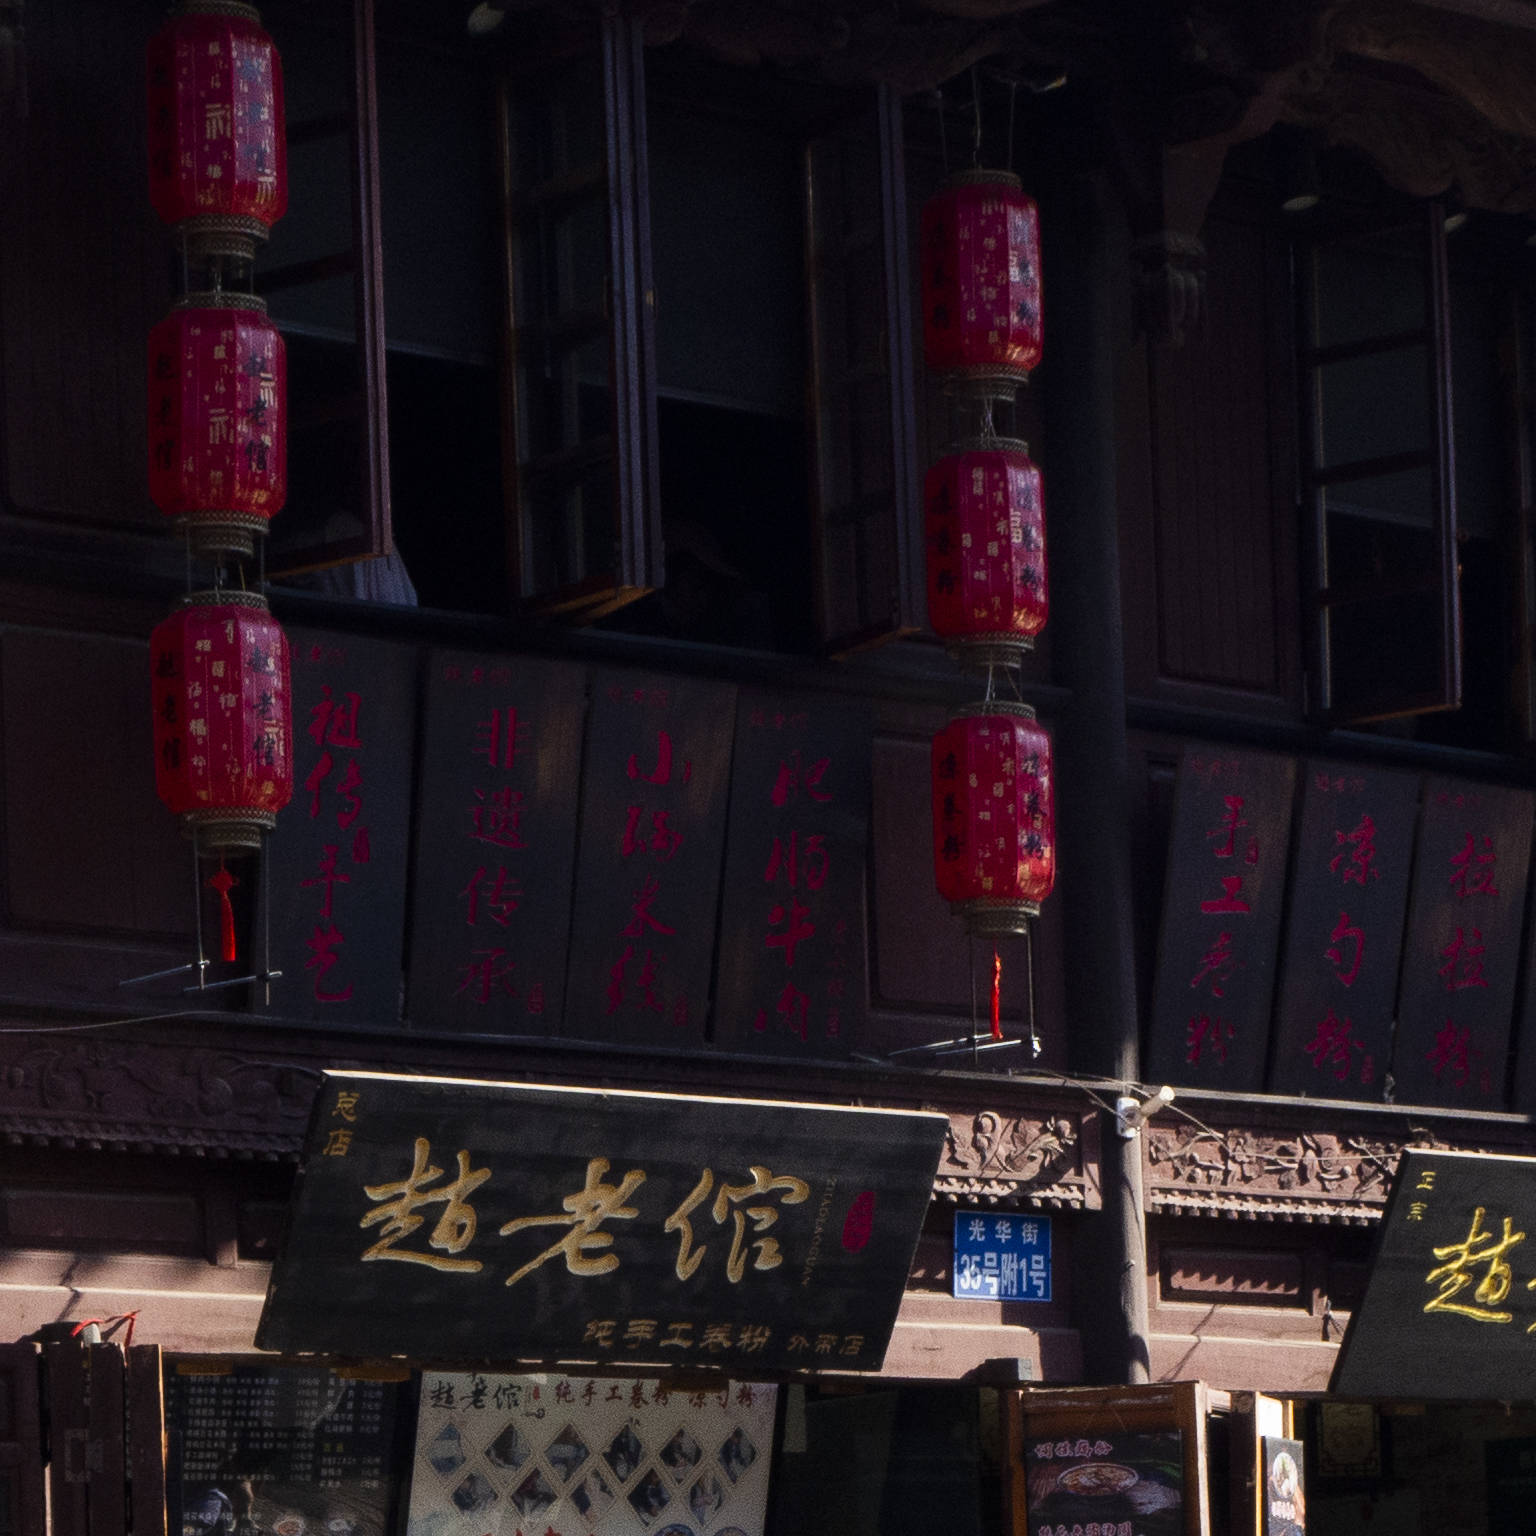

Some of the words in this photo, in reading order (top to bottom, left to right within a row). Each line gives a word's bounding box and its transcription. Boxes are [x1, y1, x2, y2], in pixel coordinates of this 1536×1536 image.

[464, 705, 532, 1006] 非遗传承
[606, 730, 692, 1015] 小锅米线
[959, 1251, 1048, 1298] 35号附1号
[968, 1218, 1039, 1246] 光华街
